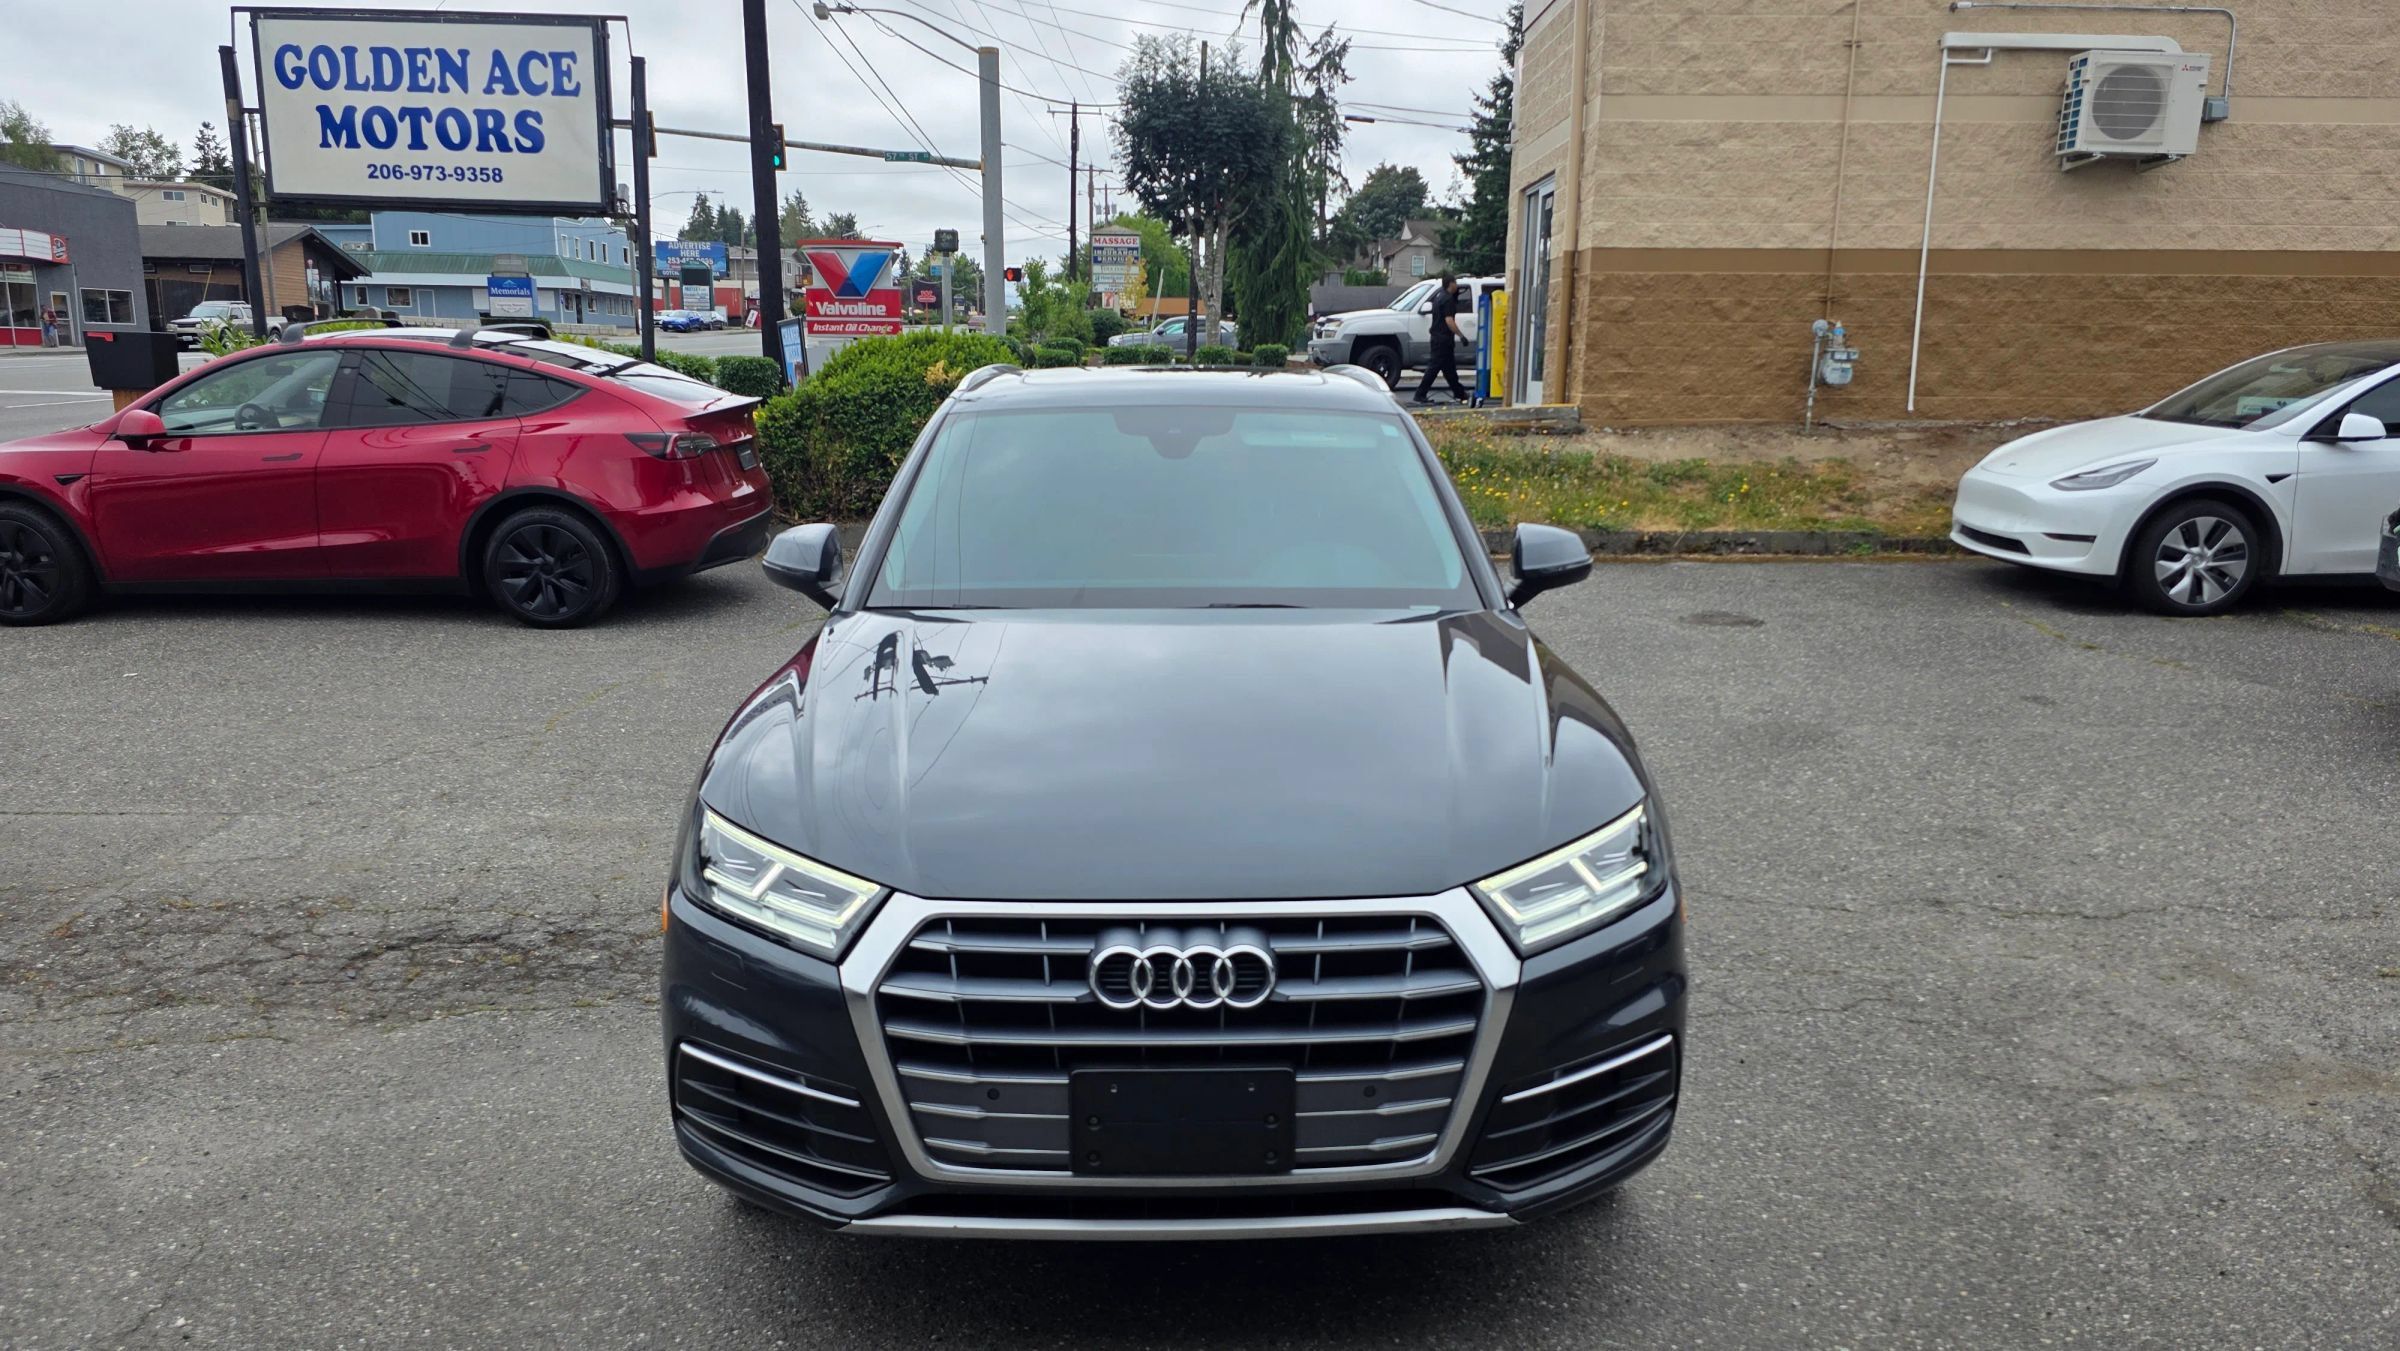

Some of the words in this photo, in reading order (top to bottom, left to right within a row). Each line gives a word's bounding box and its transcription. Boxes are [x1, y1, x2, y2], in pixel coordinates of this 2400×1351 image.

[274, 43, 470, 94] GOLDEN
[483, 49, 582, 98] ACE
[316, 104, 545, 154] MOTORS
[367, 163, 503, 183] 206-973-9358
[668, 241, 712, 250] ADVERTISE
[1093, 237, 1138, 245] MASSAGE
[680, 249, 700, 257] HERE
[490, 287, 531, 296] Memorials
[815, 301, 887, 316] Valvoline
[813, 323, 844, 332] Instant
[845, 323, 858, 332] Oil
[858, 323, 894, 334] Change
